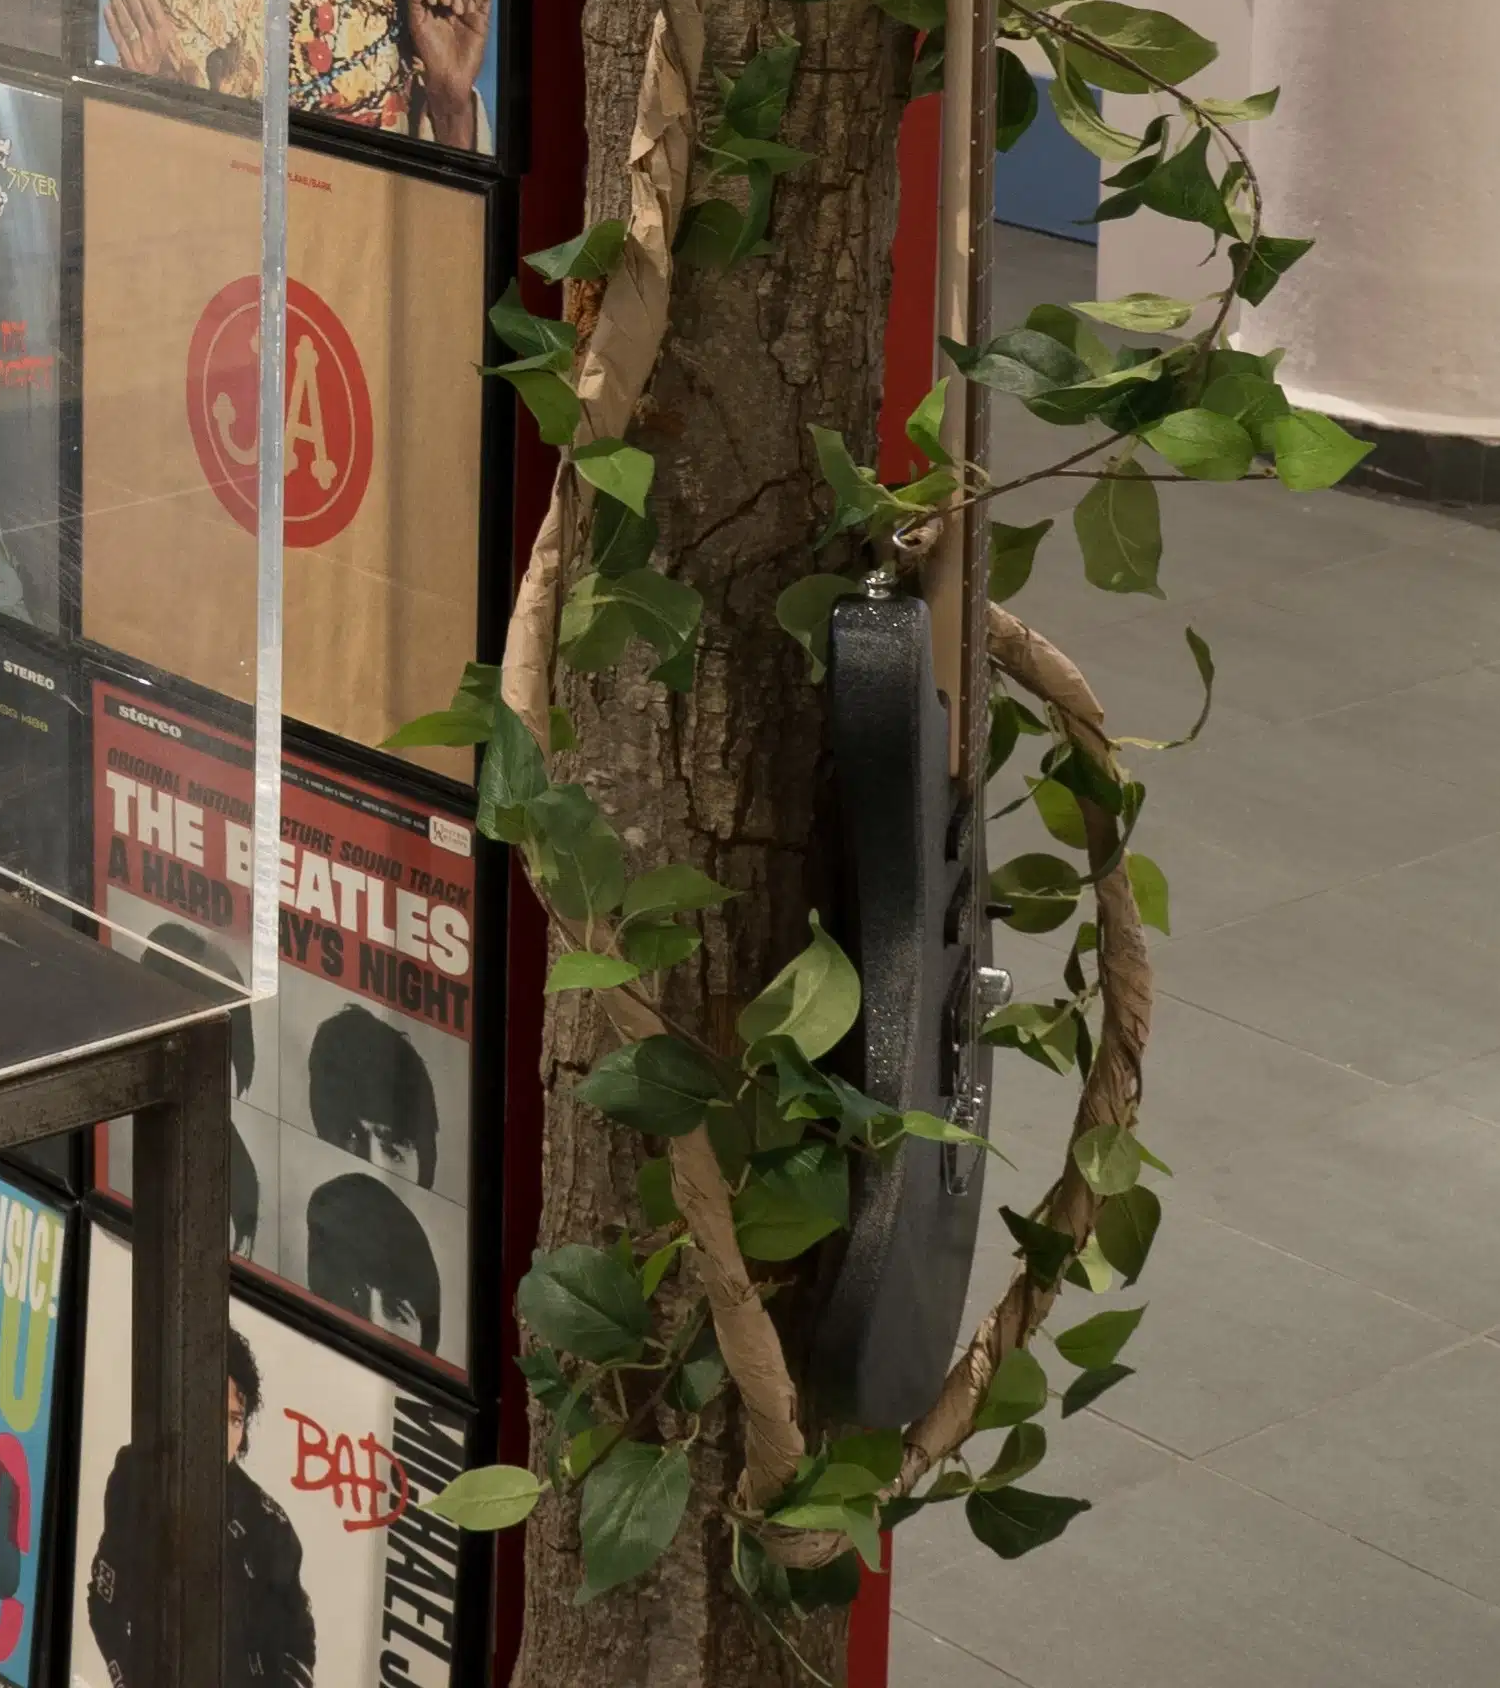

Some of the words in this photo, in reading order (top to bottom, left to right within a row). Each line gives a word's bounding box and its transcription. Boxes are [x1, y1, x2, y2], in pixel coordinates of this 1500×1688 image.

[7, 166, 59, 202] SISTER
[3, 659, 56, 691] STEREO
[118, 702, 182, 739] stereo
[105, 769, 205, 869] THE
[107, 746, 181, 795] ORIGINAL
[279, 818, 335, 859] CTURE
[339, 842, 402, 885] SOUND
[408, 866, 472, 912] TRACK
[108, 836, 130, 884] A
[141, 850, 235, 928] HARD
[278, 909, 345, 977] AY'S
[358, 939, 471, 1033] NIGHT
[283, 1407, 409, 1533] BAD
